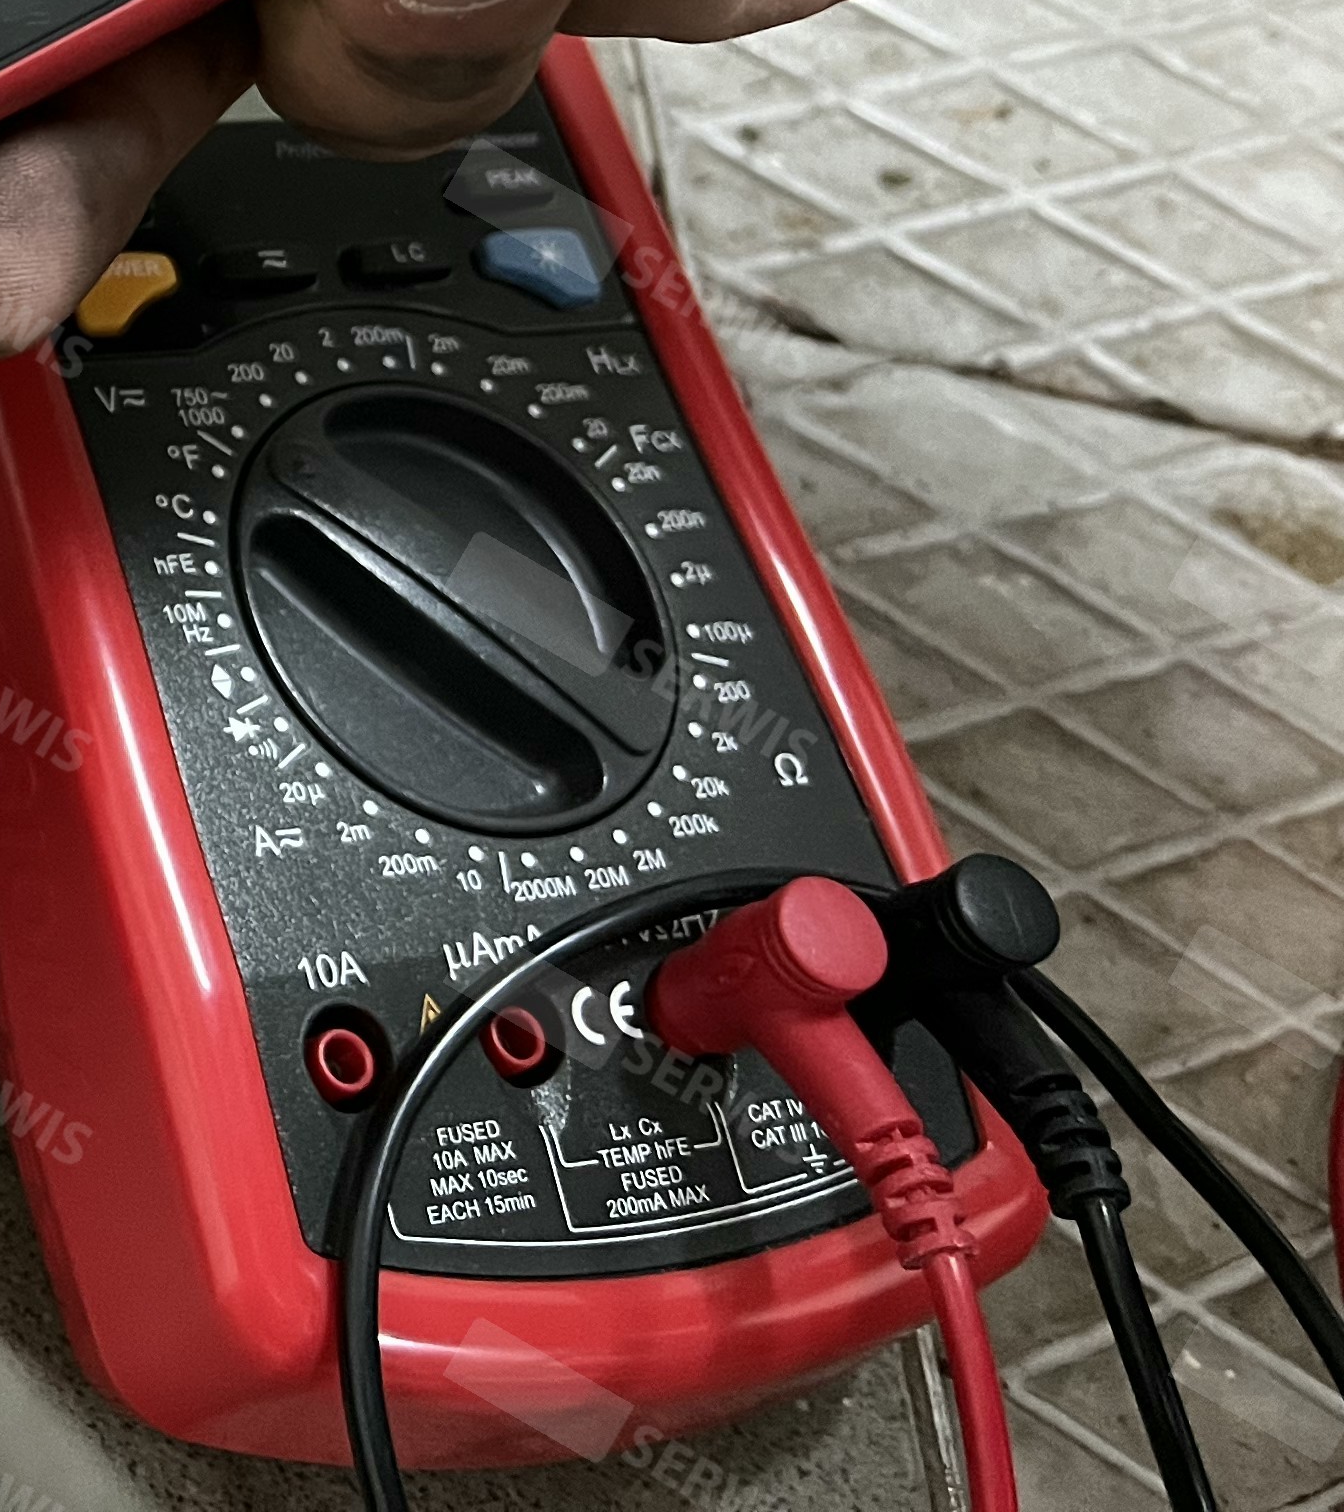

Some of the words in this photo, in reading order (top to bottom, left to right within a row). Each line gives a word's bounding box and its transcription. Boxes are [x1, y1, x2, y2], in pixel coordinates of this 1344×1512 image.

[318, 327, 335, 348] 2
[350, 325, 406, 346] 200m
[269, 342, 295, 363] 20
[228, 363, 265, 383] 200
[178, 406, 226, 428] 1000
[163, 602, 208, 624] 10M
[182, 624, 214, 644] Hz
[714, 680, 751, 703] 200
[691, 776, 730, 799] 20k
[336, 821, 372, 843] 2m
[668, 813, 720, 838] 200k
[378, 852, 440, 878] 200m
[633, 848, 667, 872] 2M
[456, 869, 482, 892] 10
[512, 875, 578, 902] 2000M
[584, 865, 630, 890] 20M
[298, 950, 369, 991] 10A
[747, 1099, 782, 1123] CAT
[436, 1119, 501, 1147] FUSED
[608, 1123, 632, 1141] Lx
[638, 1117, 663, 1136] Cx
[751, 1125, 786, 1150] CAT
[789, 1122, 808, 1143] III
[432, 1149, 468, 1171] 10A
[473, 1140, 517, 1165] MAX
[596, 1143, 652, 1168] TEMP
[654, 1137, 692, 1161] hFE
[430, 1173, 474, 1197] MAX
[477, 1168, 529, 1189] 10sec
[620, 1165, 683, 1192] FUSED
[426, 1198, 481, 1225] EACH
[485, 1190, 537, 1216] 15min
[606, 1192, 669, 1218] 200mA
[667, 1184, 711, 1208] MAX
